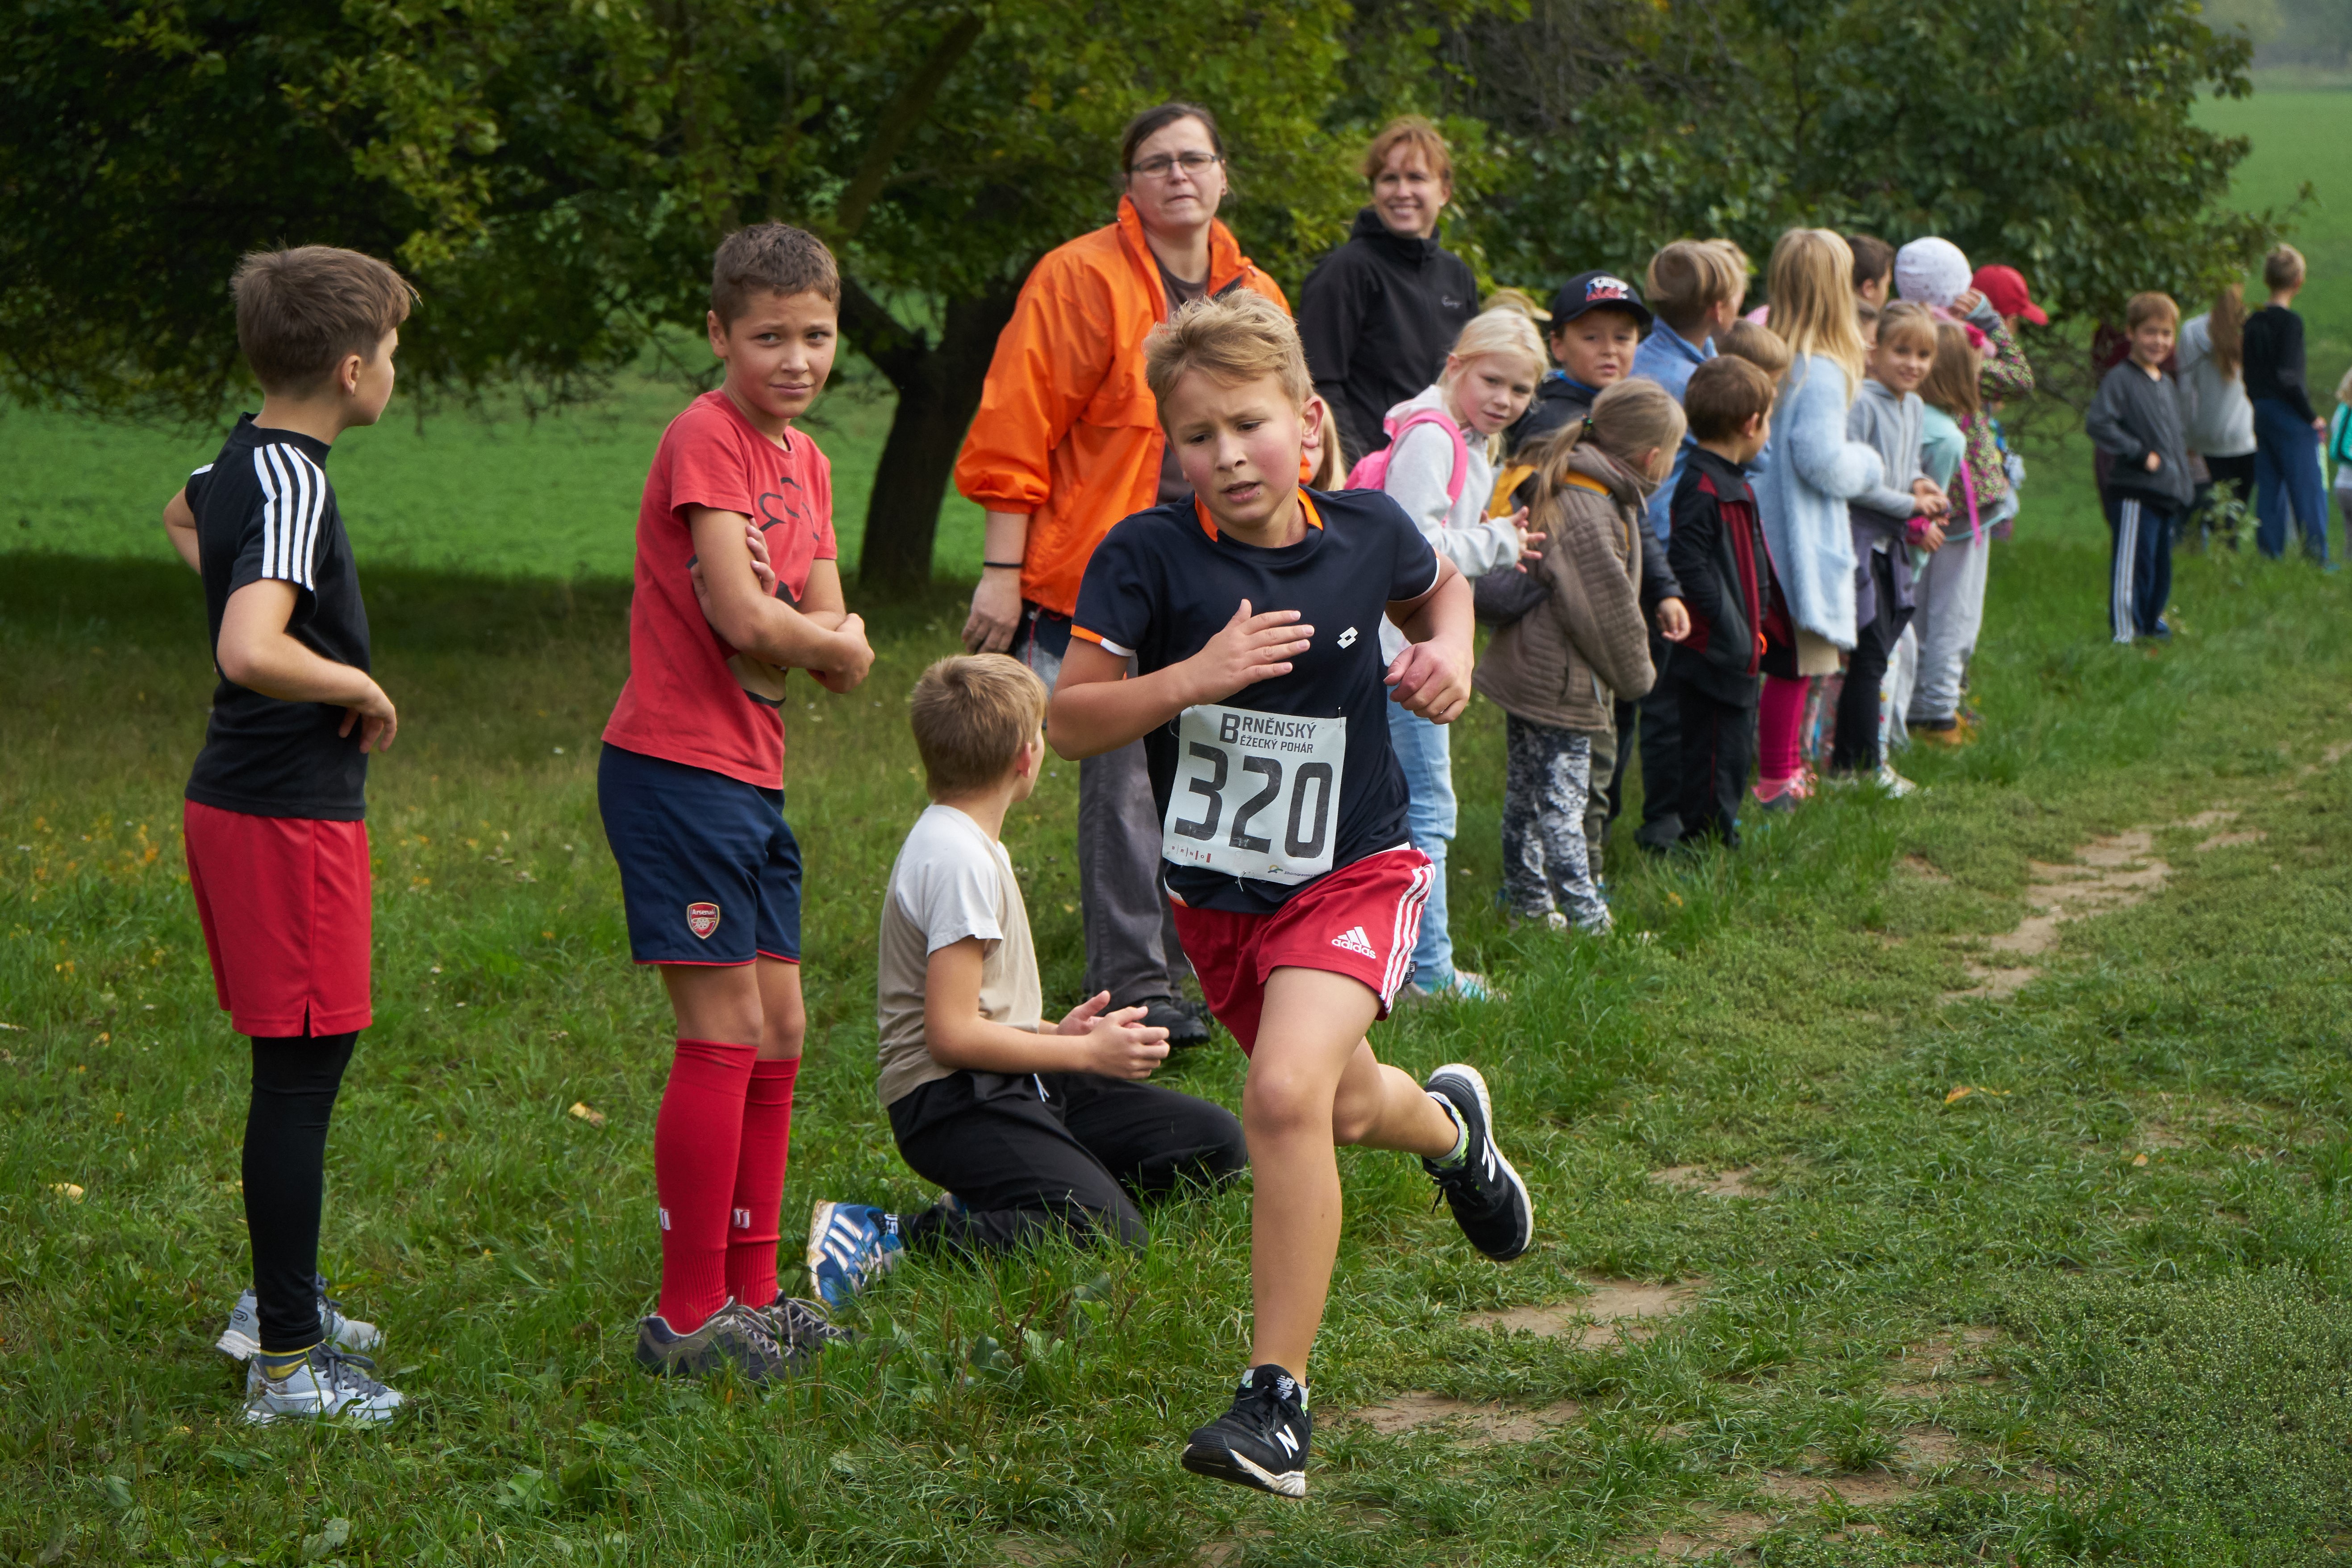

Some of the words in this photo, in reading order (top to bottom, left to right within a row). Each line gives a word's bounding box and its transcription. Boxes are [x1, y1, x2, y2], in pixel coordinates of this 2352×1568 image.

[1280, 742, 1314, 753] POHÁR
[1174, 741, 1333, 859] 320
[1331, 938, 1376, 959] adidas
[1275, 1424, 1300, 1459] N
